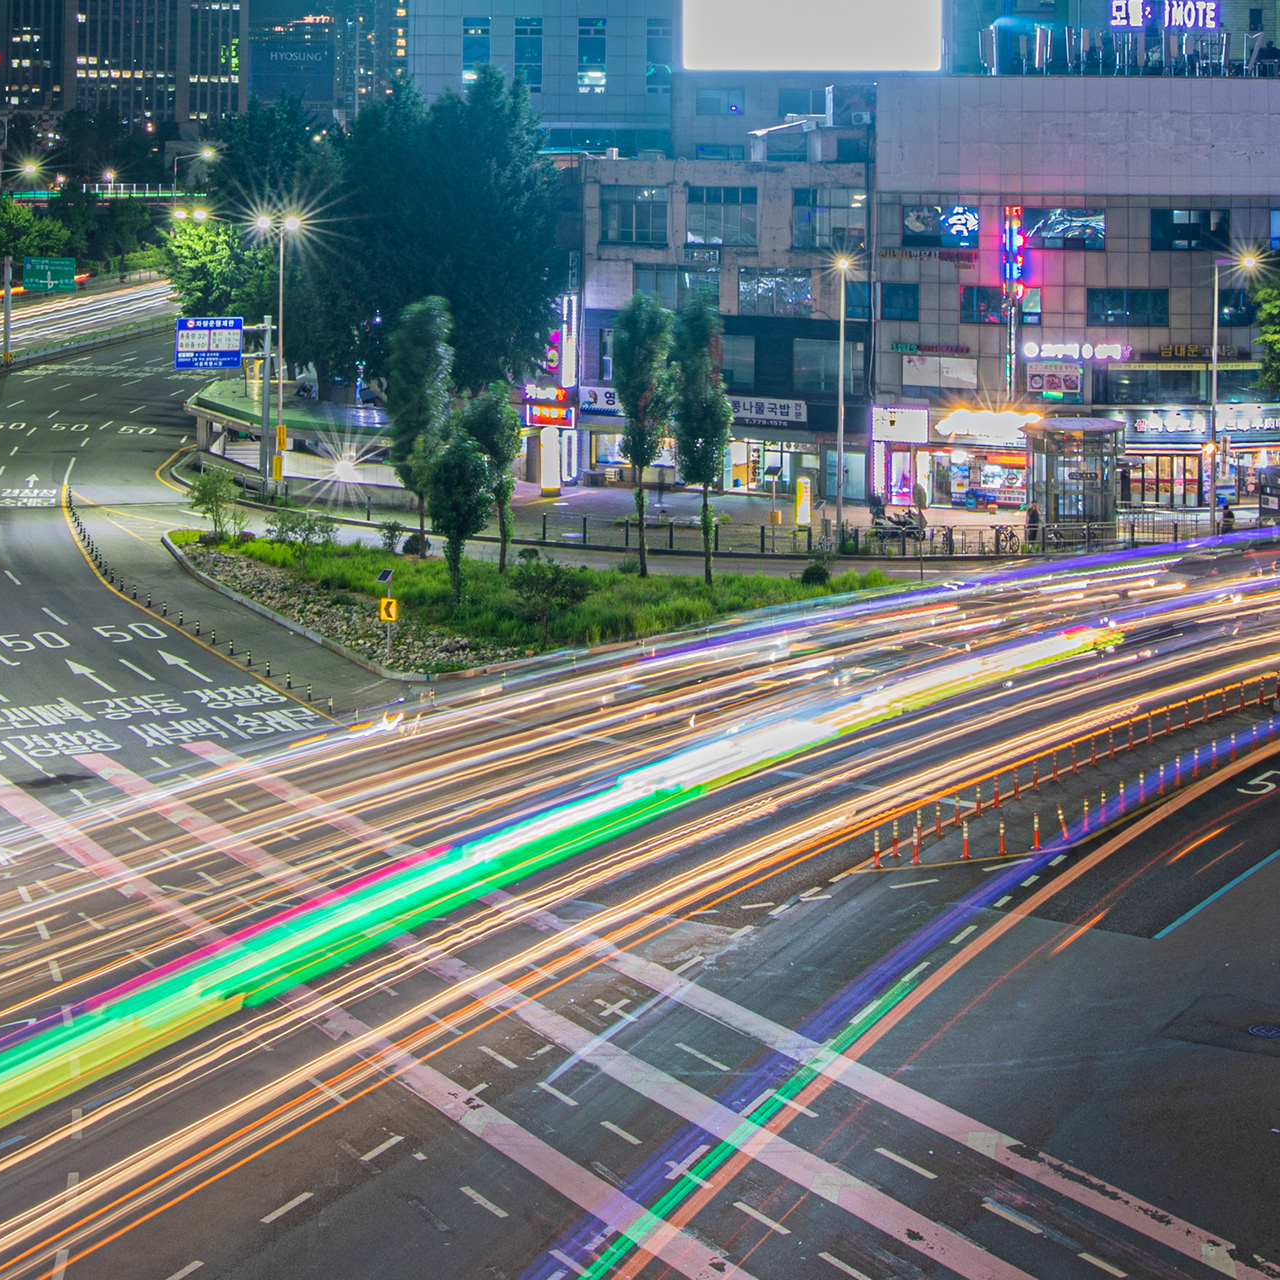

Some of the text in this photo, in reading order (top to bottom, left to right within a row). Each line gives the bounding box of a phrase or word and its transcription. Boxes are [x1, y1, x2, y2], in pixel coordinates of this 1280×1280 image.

[1161, 345, 1199, 357] 남대문
[731, 399, 791, 417] 콩나물국밥
[50, 422, 89, 432] 50
[117, 425, 157, 436] 50
[1, 488, 57, 498] 경찰청
[92, 622, 168, 643] 50
[183, 683, 288, 709] 경찰청
[82, 693, 188, 720] 공덕동
[127, 716, 229, 748] 서부역
[6, 729, 122, 757] 경찰청
